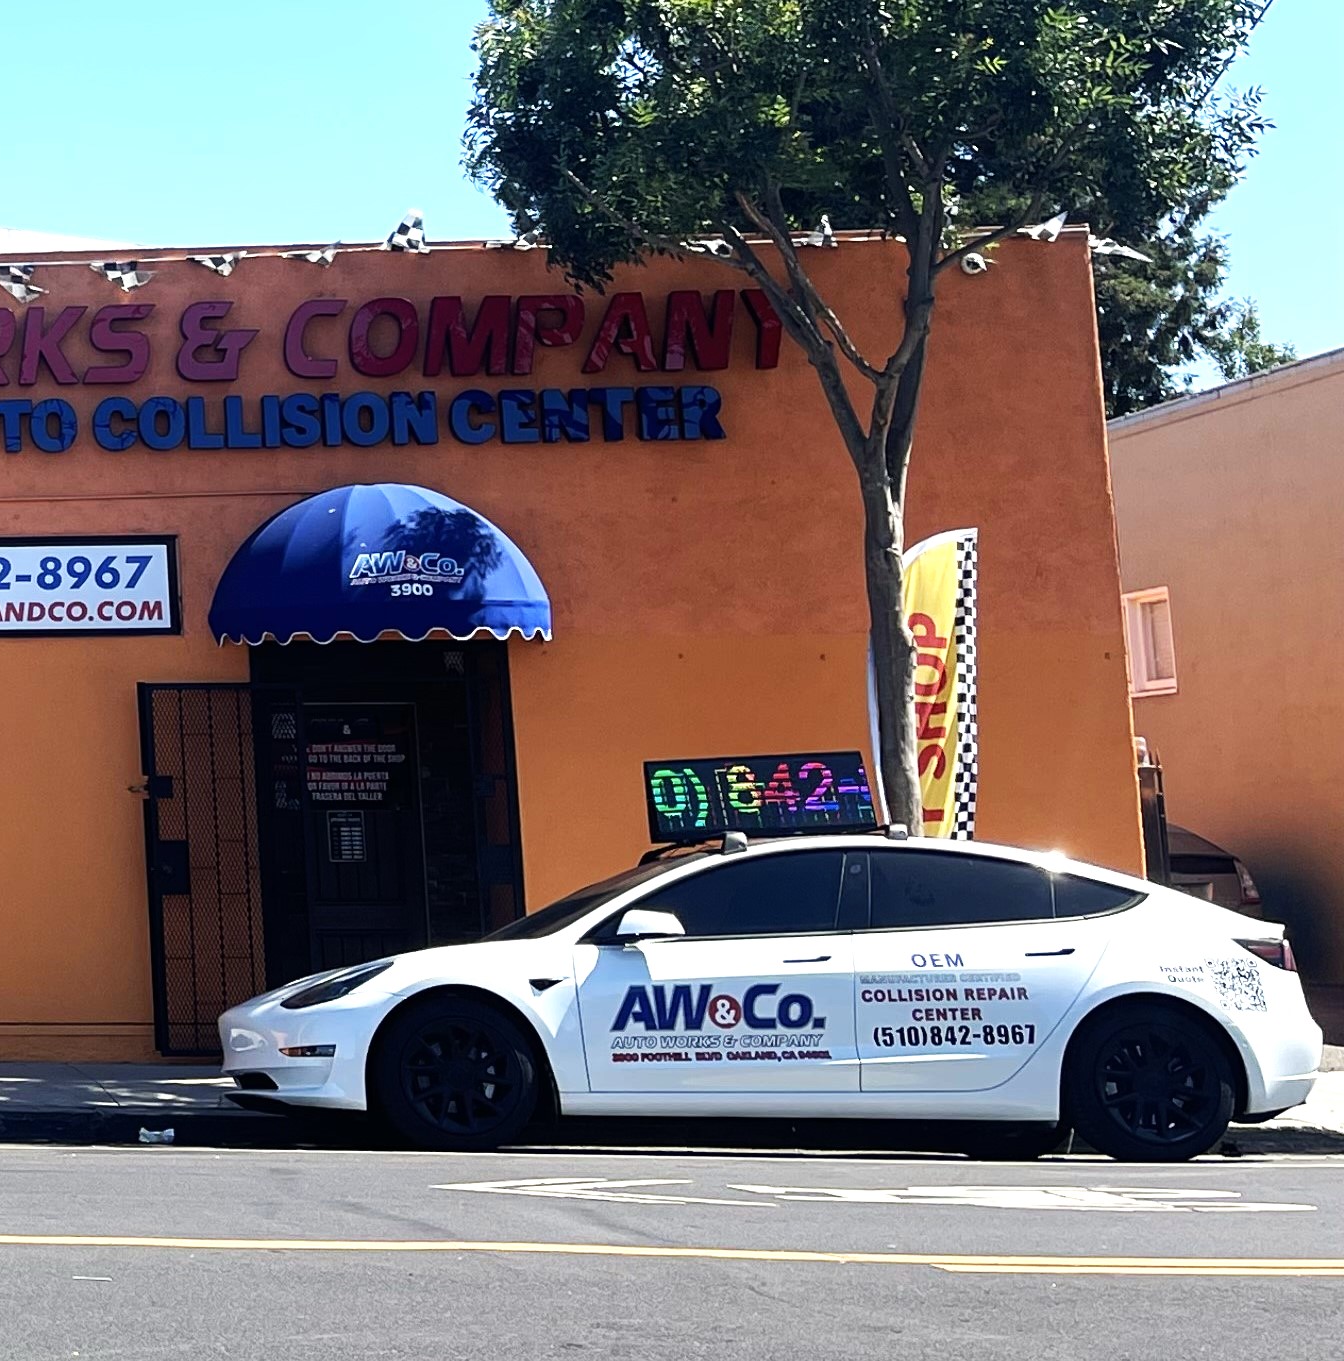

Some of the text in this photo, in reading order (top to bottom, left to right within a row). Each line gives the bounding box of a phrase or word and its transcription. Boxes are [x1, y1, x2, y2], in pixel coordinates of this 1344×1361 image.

[175, 299, 259, 383] &
[284, 288, 784, 380] COMPANY
[93, 389, 439, 452] COLLISION
[449, 385, 726, 447] CENTER
[348, 549, 465, 579] AW&Co.
[390, 583, 434, 597] 3900
[908, 612, 947, 780] SHOP
[724, 761, 875, 814] 842-
[911, 953, 964, 968] OEM
[861, 987, 1030, 1003] COLLISION REPAIR
[609, 982, 827, 1033] AW&Co.
[911, 1007, 983, 1022] CENTER
[611, 1033, 825, 1050] AUTO WORKS & COMPANY
[873, 1024, 1036, 1047] (510)842-8967
[640, 1051, 693, 1062] FOOTHILL
